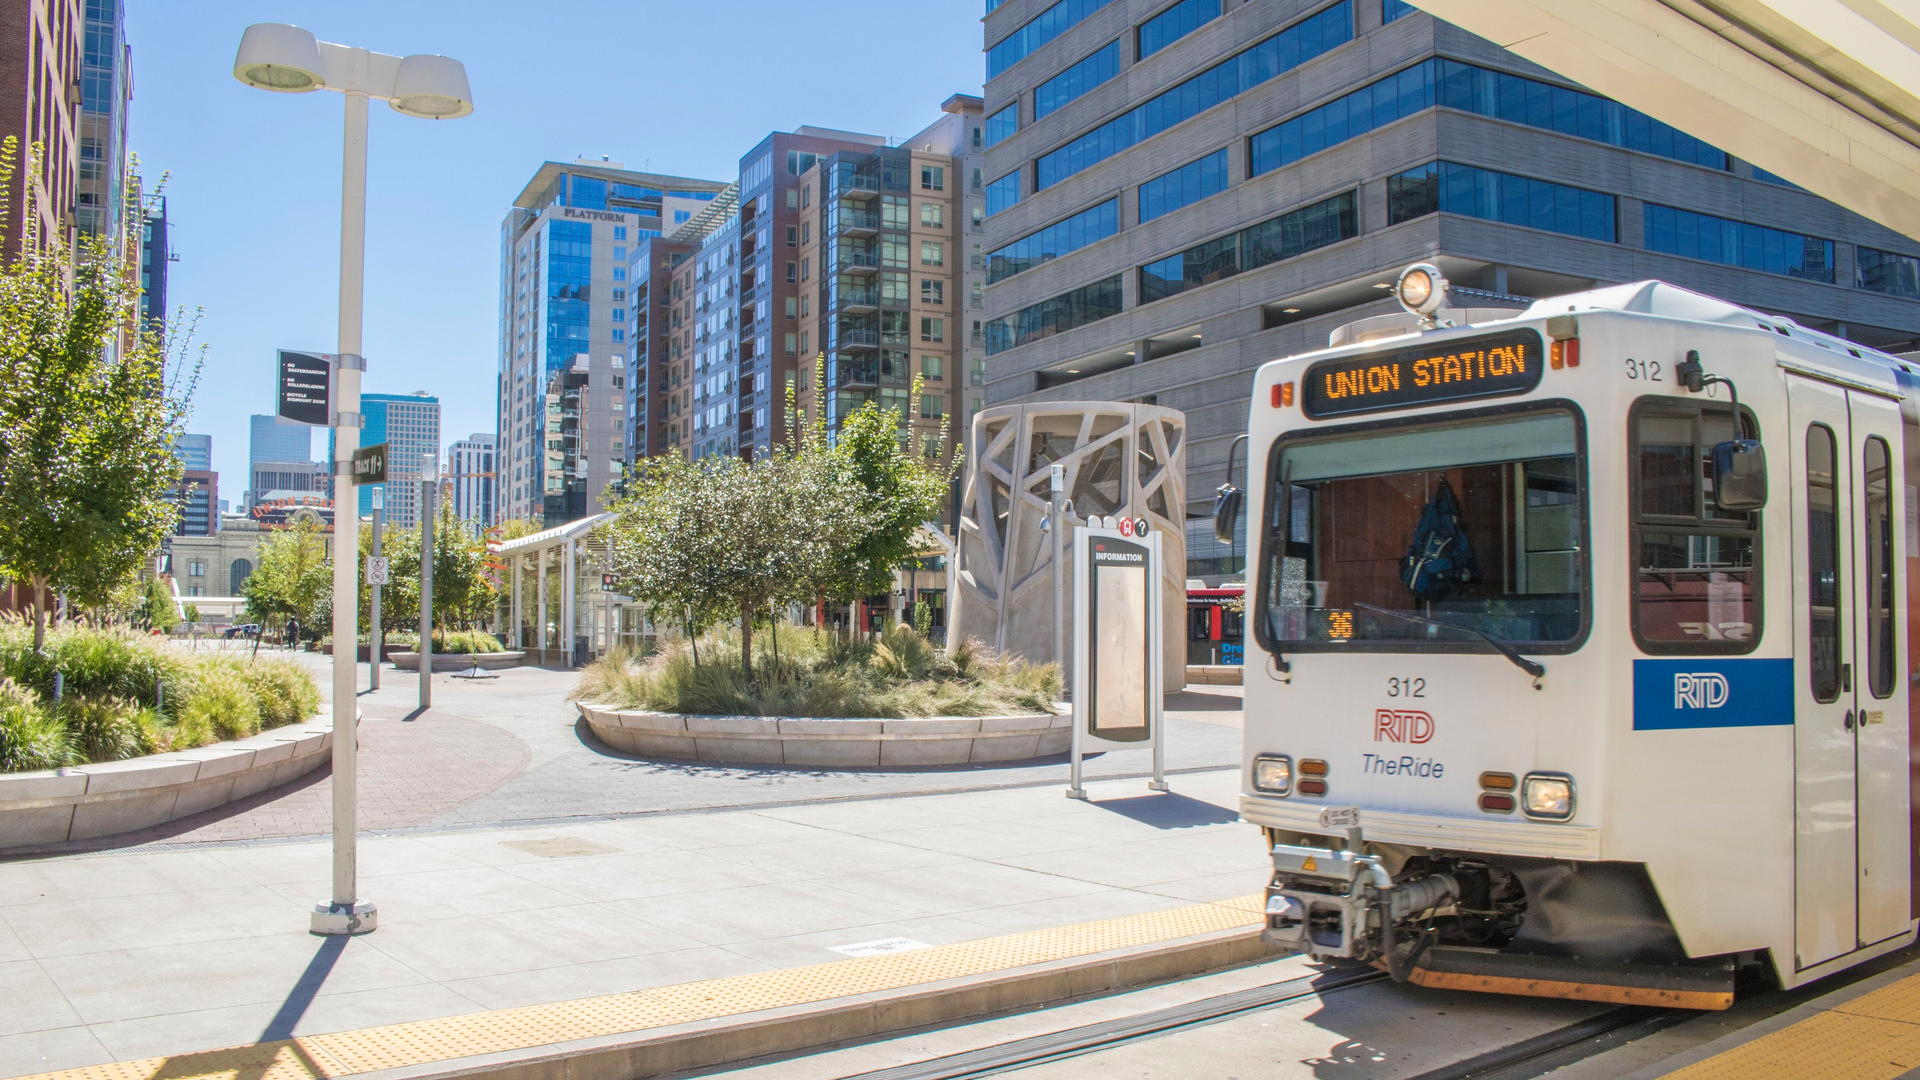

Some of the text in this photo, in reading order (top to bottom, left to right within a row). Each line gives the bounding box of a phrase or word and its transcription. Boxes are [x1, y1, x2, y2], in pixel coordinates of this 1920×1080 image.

[564, 208, 625, 223] PLATFORM
[1325, 344, 1525, 399] UNION STATION
[1625, 358, 1662, 382] 312
[354, 454, 377, 474] TRACK 11
[252, 496, 295, 518] UNION
[1096, 552, 1142, 562] INFORMATION
[1328, 612, 1352, 638] 36
[1387, 677, 1426, 698] 312
[1674, 672, 1729, 709] RTD
[1374, 708, 1435, 744] RTD
[1362, 754, 1444, 778] TheRide
